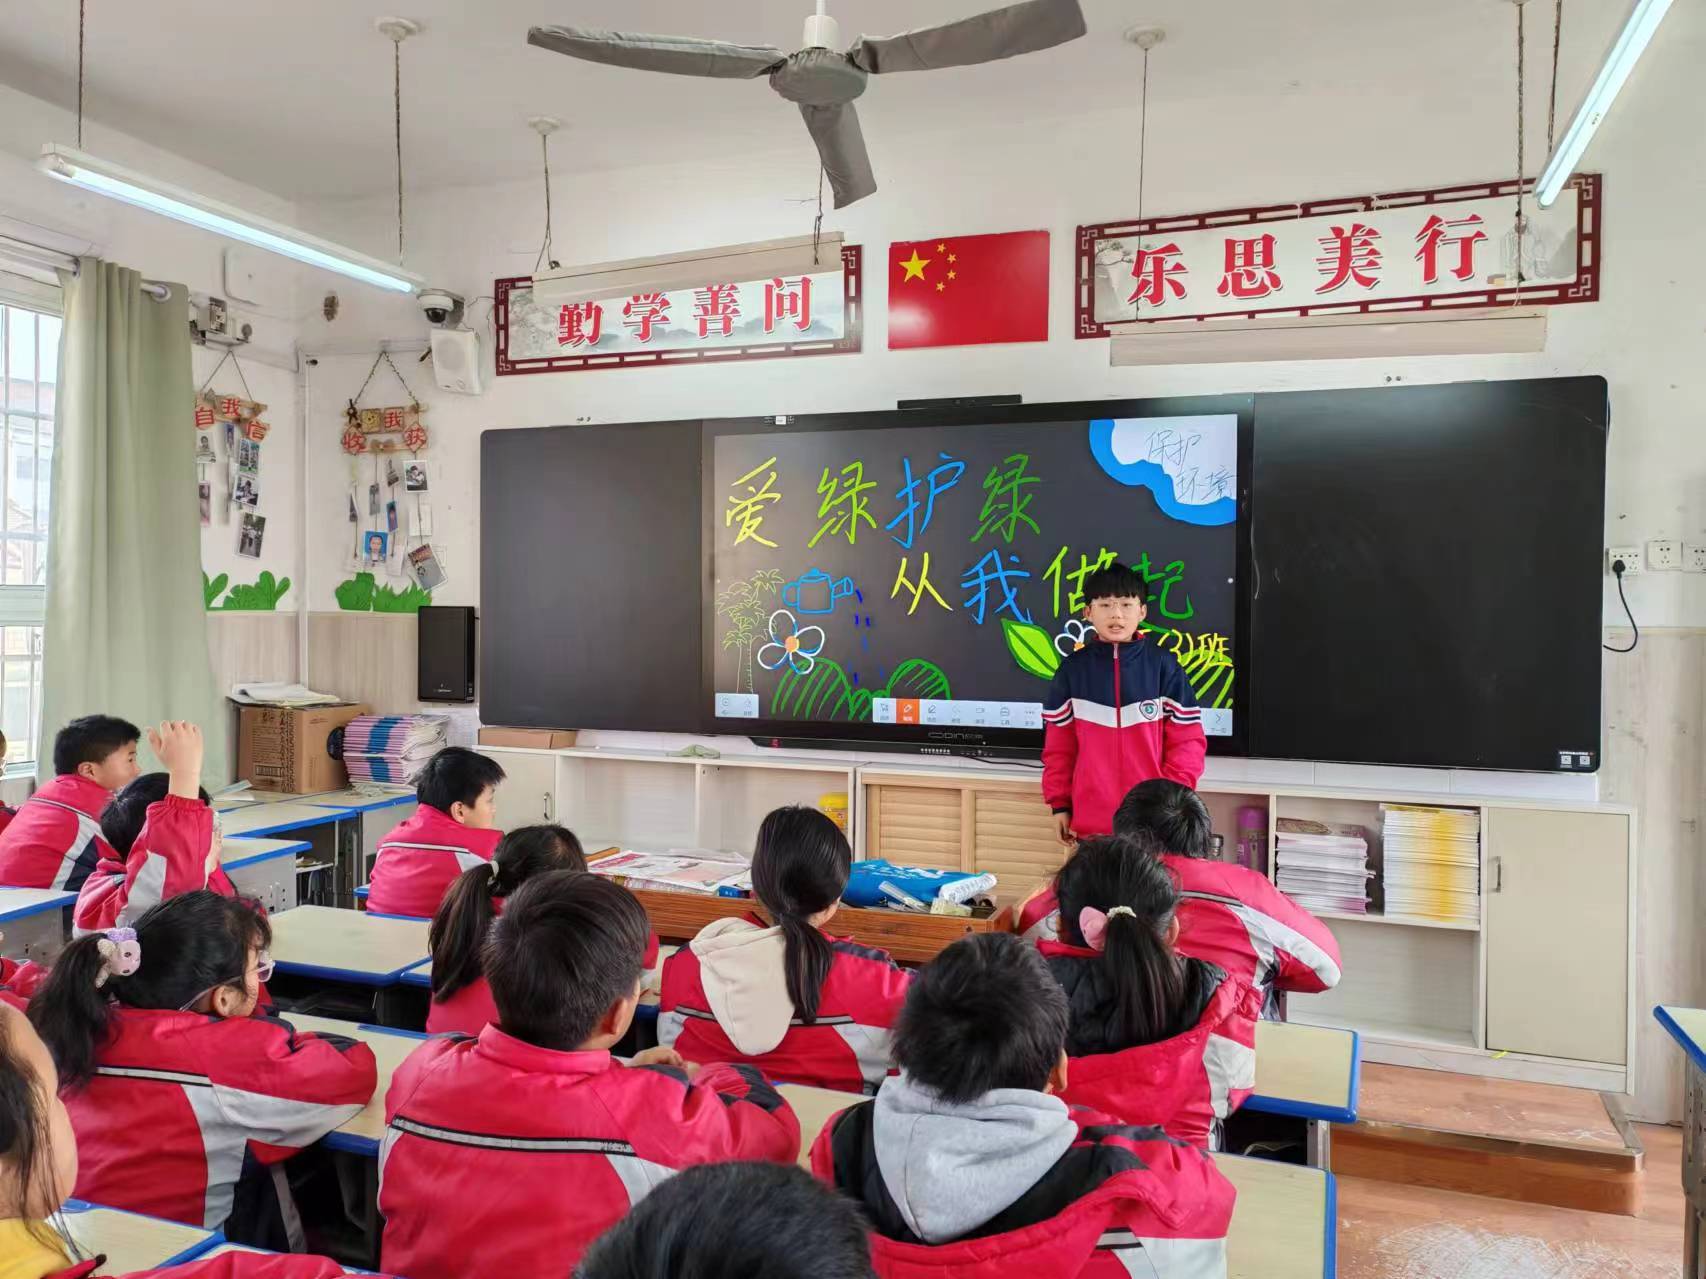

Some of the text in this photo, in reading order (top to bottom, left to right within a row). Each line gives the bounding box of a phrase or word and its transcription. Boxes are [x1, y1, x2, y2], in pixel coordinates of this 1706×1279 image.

[1128, 213, 1487, 306] 乐思美行
[558, 276, 813, 347] 勤学善问
[1145, 429, 1202, 471] 保护
[725, 453, 1041, 549] 爱绿护绿
